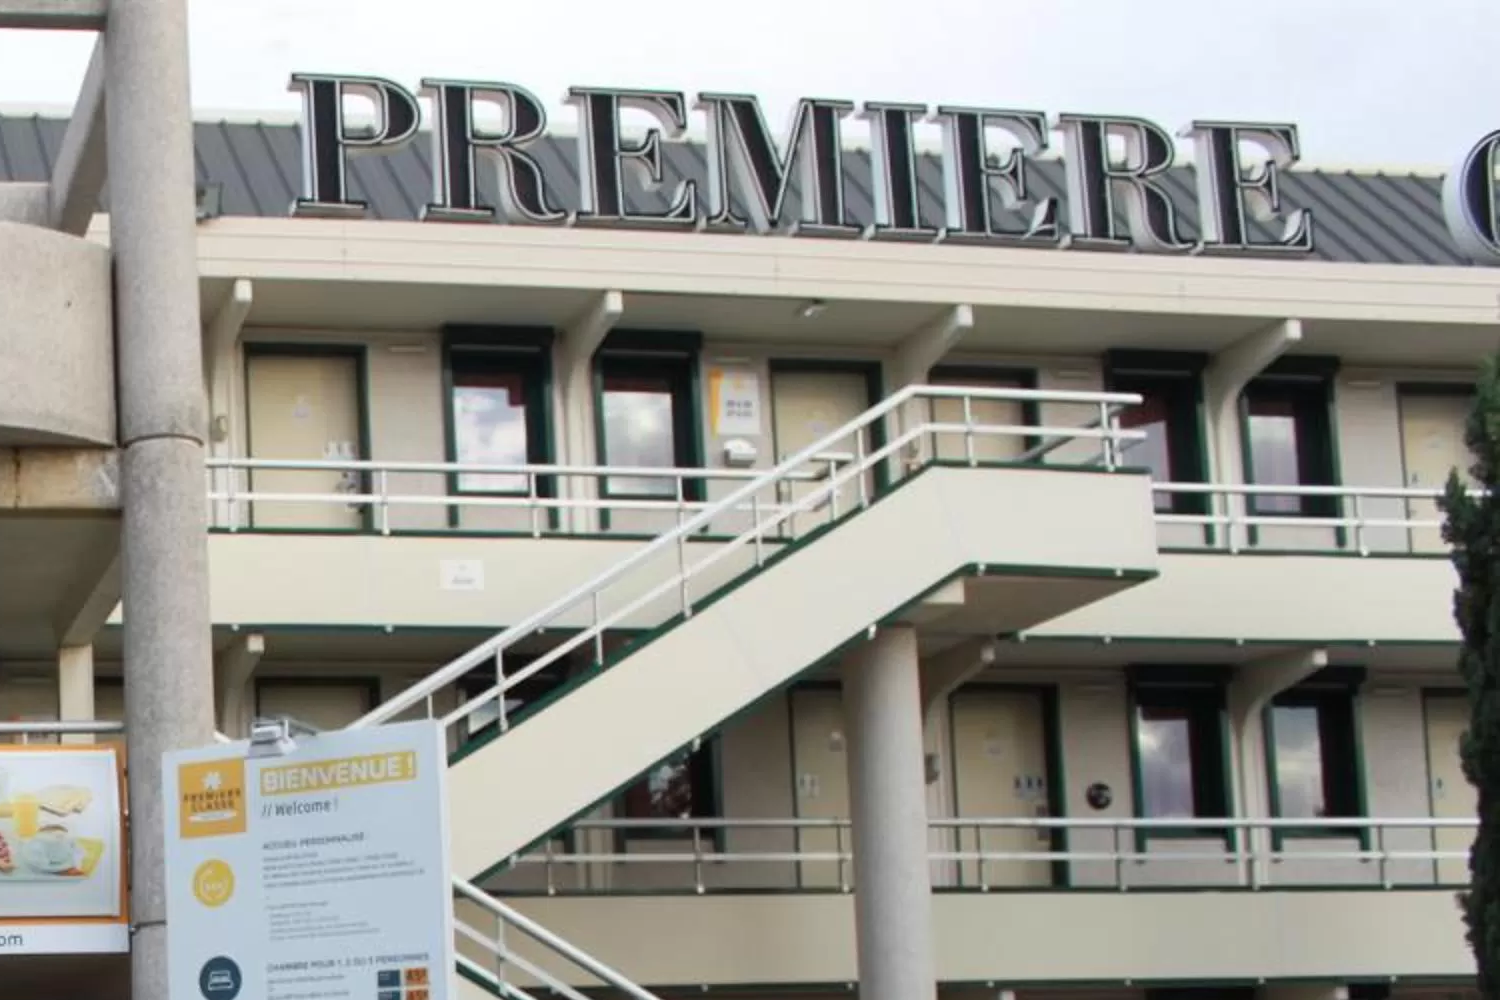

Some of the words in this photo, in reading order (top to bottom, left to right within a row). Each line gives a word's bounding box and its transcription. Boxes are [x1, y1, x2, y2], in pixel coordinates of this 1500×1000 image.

[287, 71, 1316, 256] PREMIERE
[263, 755, 402, 793] BIENVENUE
[275, 799, 332, 817] Welcome
